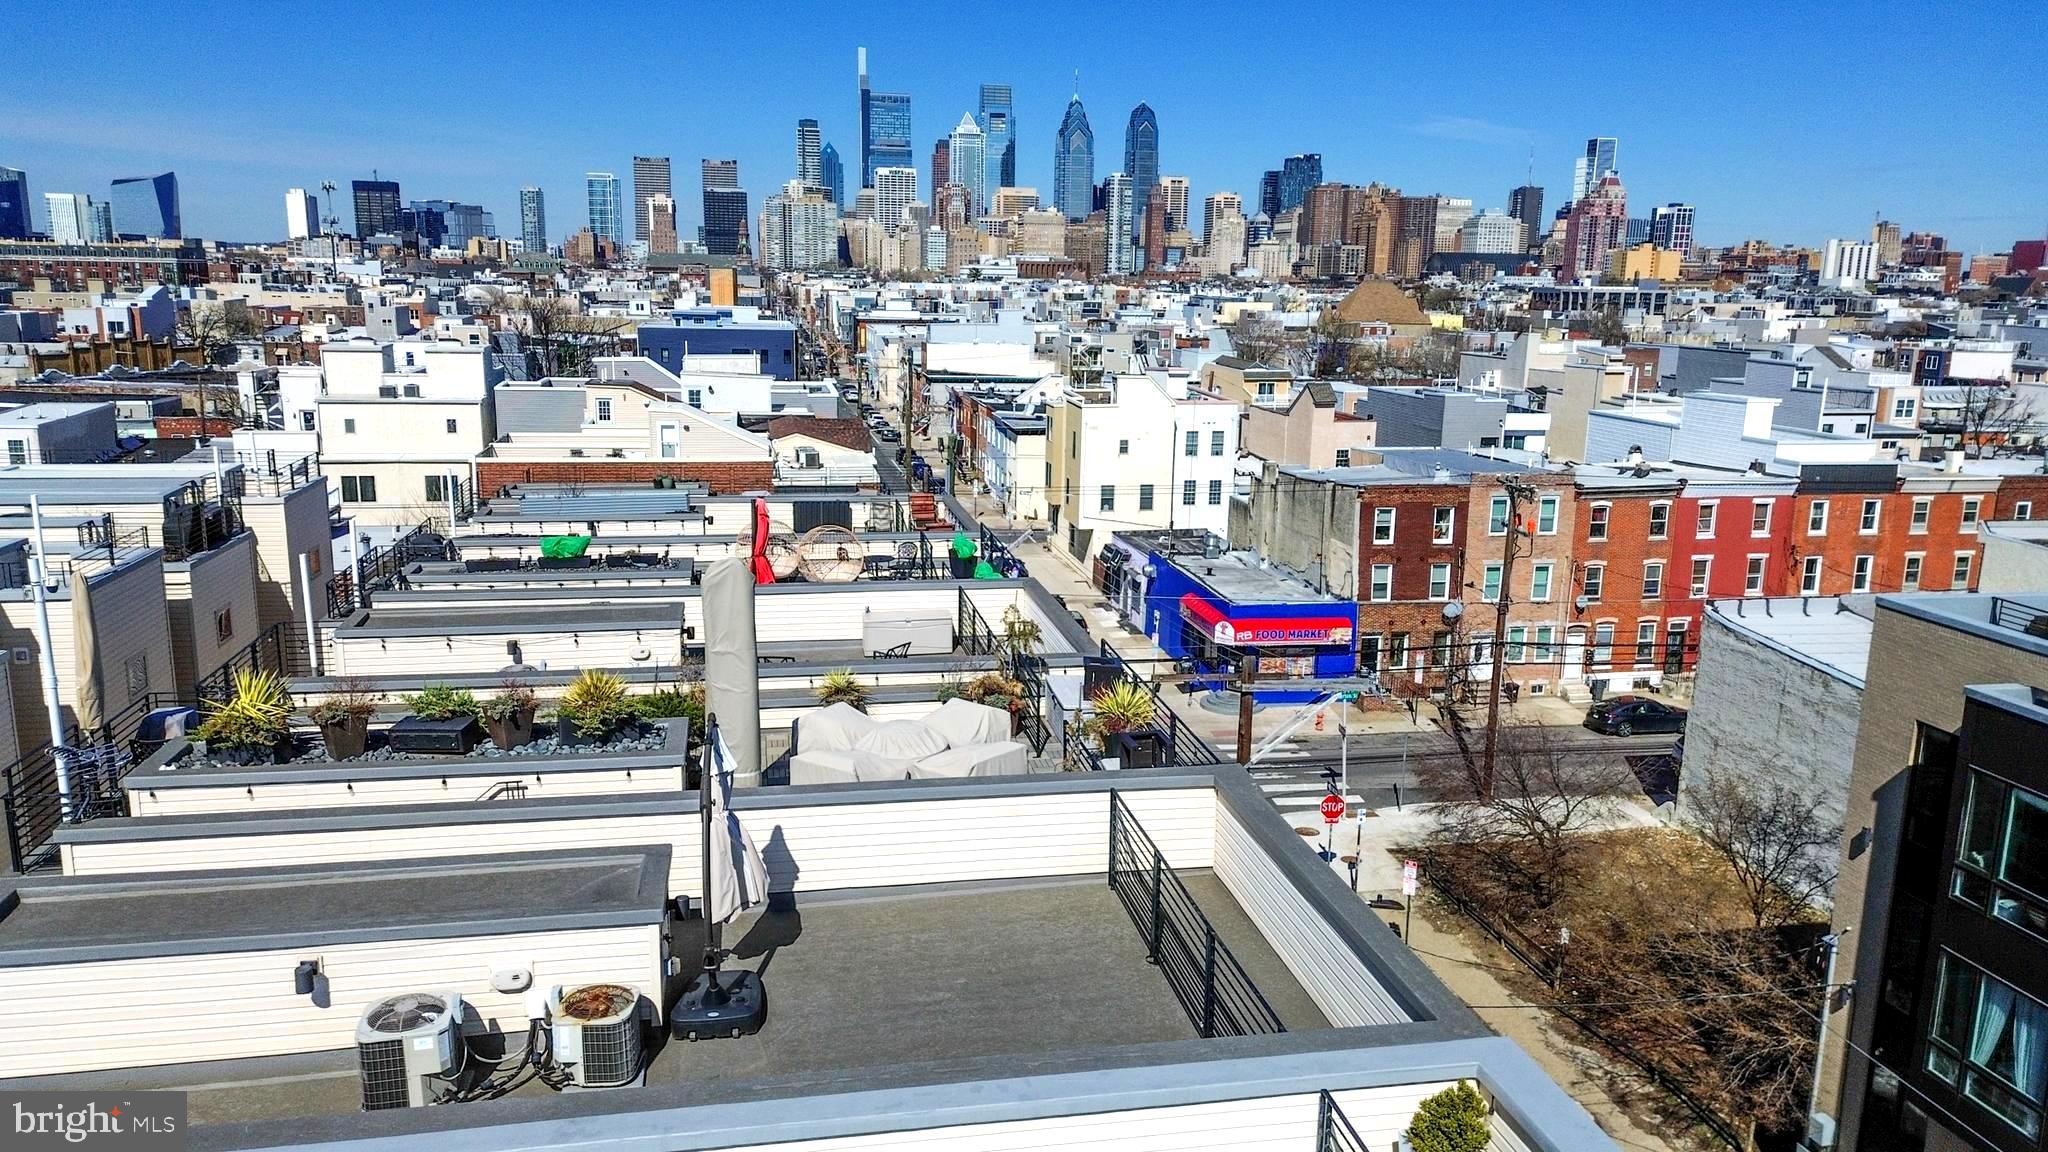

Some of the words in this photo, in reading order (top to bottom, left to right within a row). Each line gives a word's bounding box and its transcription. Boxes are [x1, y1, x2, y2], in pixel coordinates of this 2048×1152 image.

[1236, 631, 1253, 641] RB
[1256, 629, 1285, 640] FOOD
[1288, 629, 1330, 639] MARKET
[1322, 802, 1344, 812] STOP
